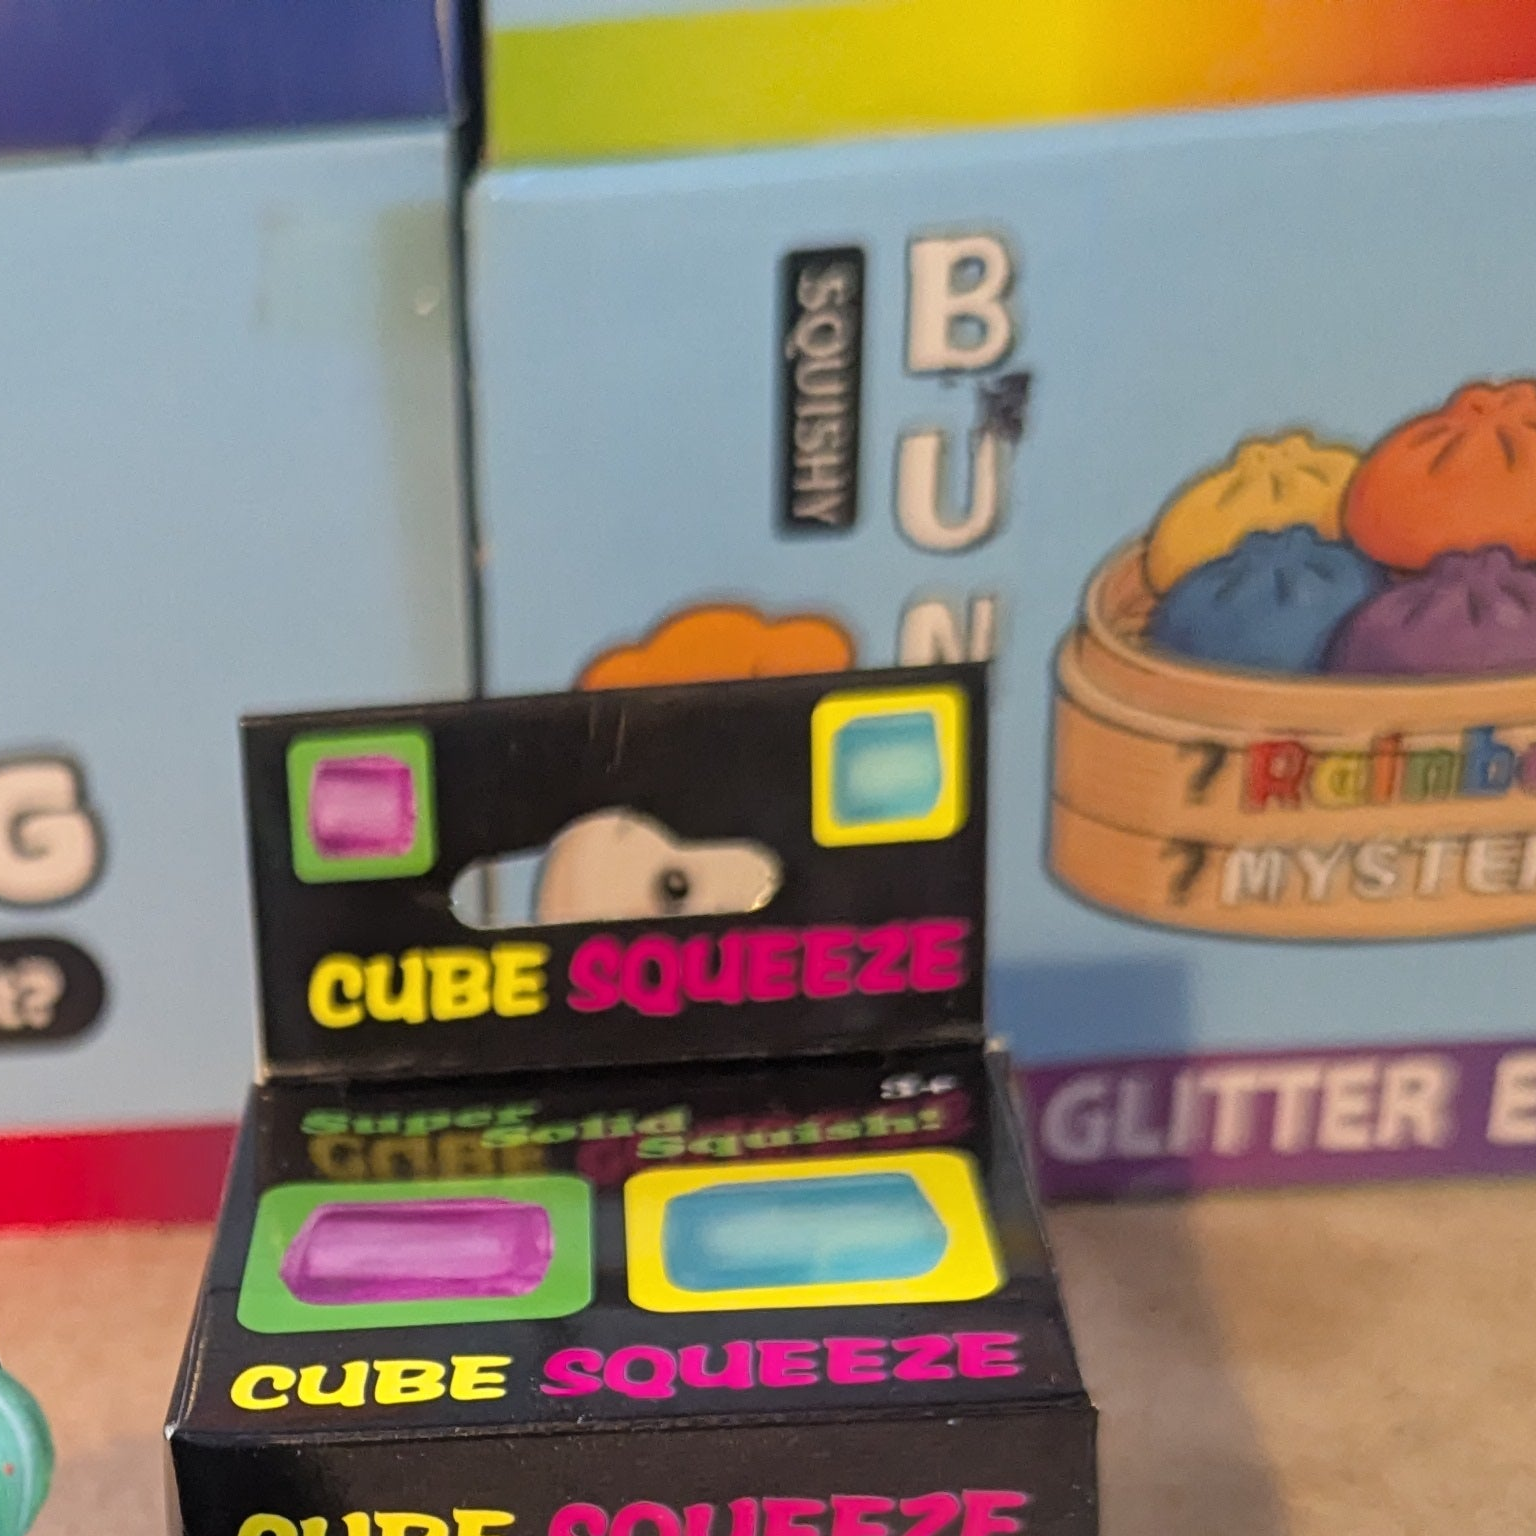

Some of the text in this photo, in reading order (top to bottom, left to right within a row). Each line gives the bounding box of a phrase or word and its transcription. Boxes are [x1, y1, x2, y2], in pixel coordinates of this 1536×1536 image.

[786, 262, 853, 526] SQUISHY
[308, 918, 970, 1029] CUBE SQUEEZE
[300, 1100, 539, 1135] Super
[480, 1106, 690, 1149] Solid
[635, 1107, 943, 1159] Squish!
[1040, 1050, 1456, 1162] GLITTER
[230, 1331, 1024, 1410] CUBE SQUEEZE
